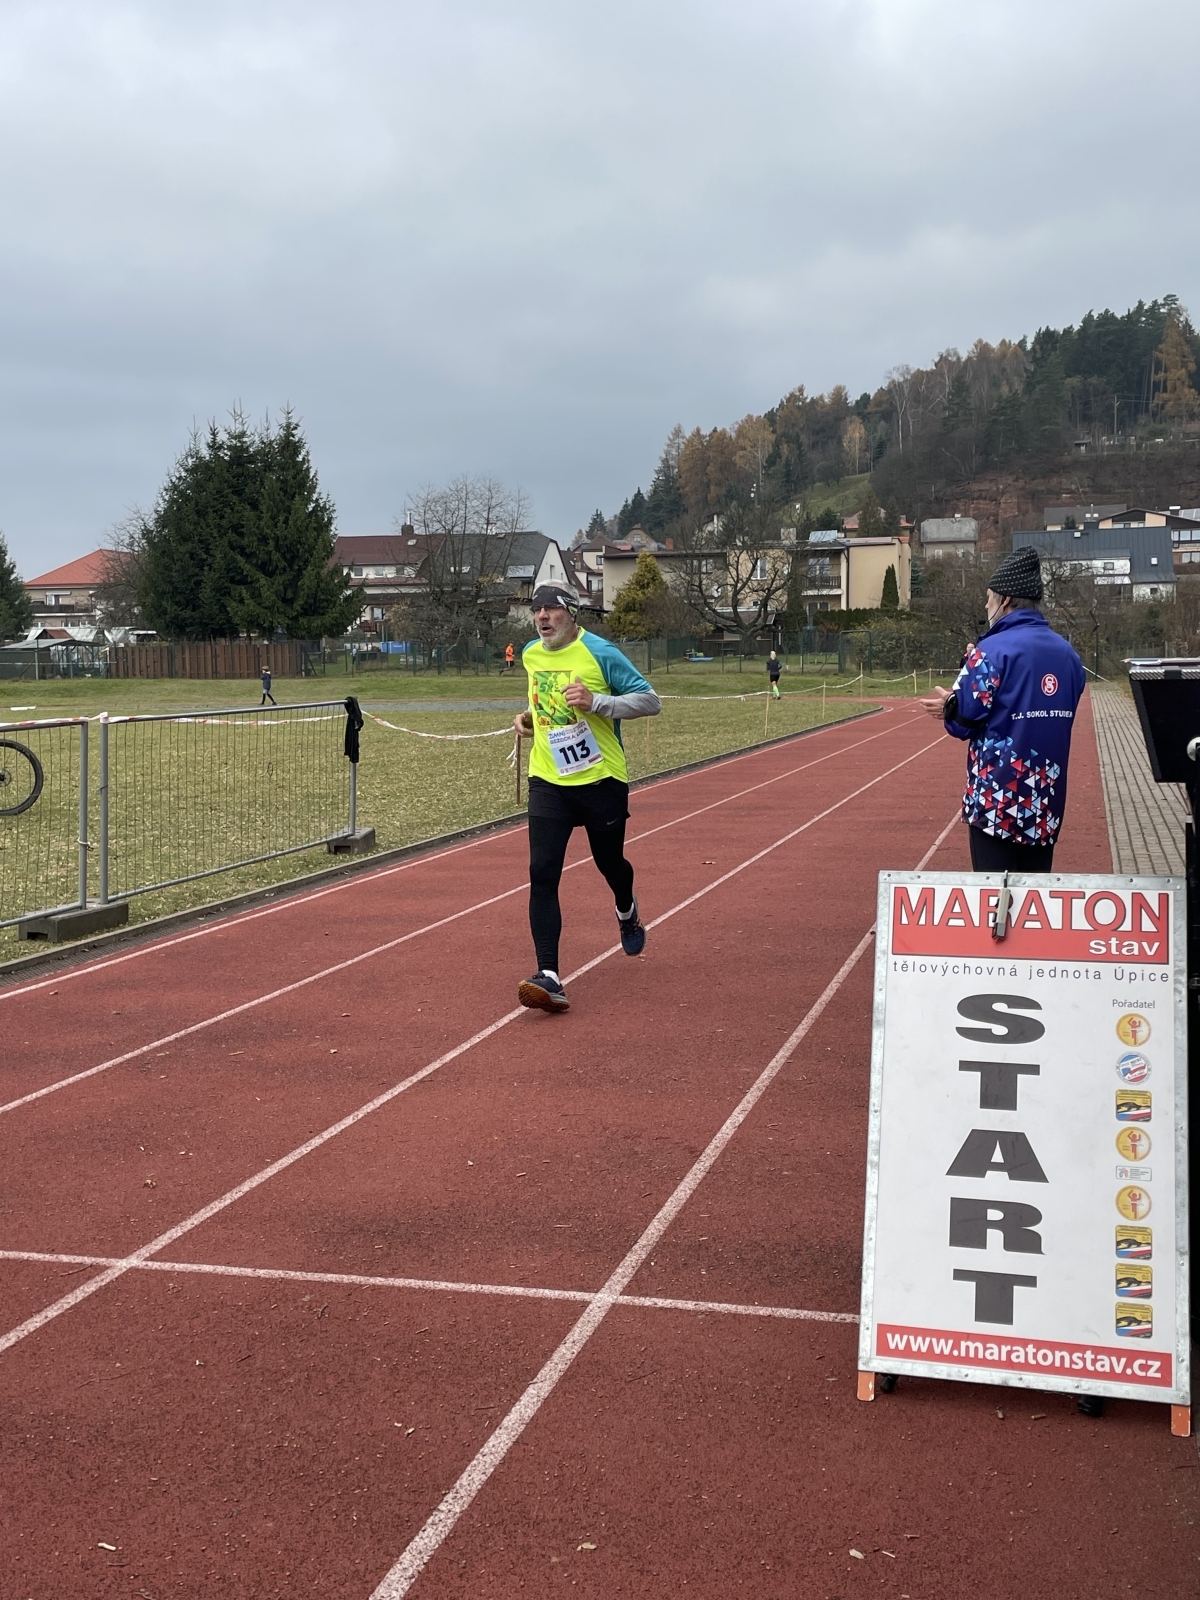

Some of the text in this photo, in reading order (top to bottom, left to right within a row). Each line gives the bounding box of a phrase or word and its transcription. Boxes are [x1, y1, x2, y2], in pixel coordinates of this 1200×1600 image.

[1026, 710, 1049, 718] SOKOL
[558, 739, 591, 765] 113
[892, 886, 1170, 933] MARATON
[1088, 936, 1161, 957] stav
[892, 961, 1170, 984] tělovýchovná jednota Úpice
[1112, 998, 1156, 1009] Pořadatel
[945, 993, 1049, 1326] START
[886, 1332, 1162, 1379] www.maratonstav.cz
